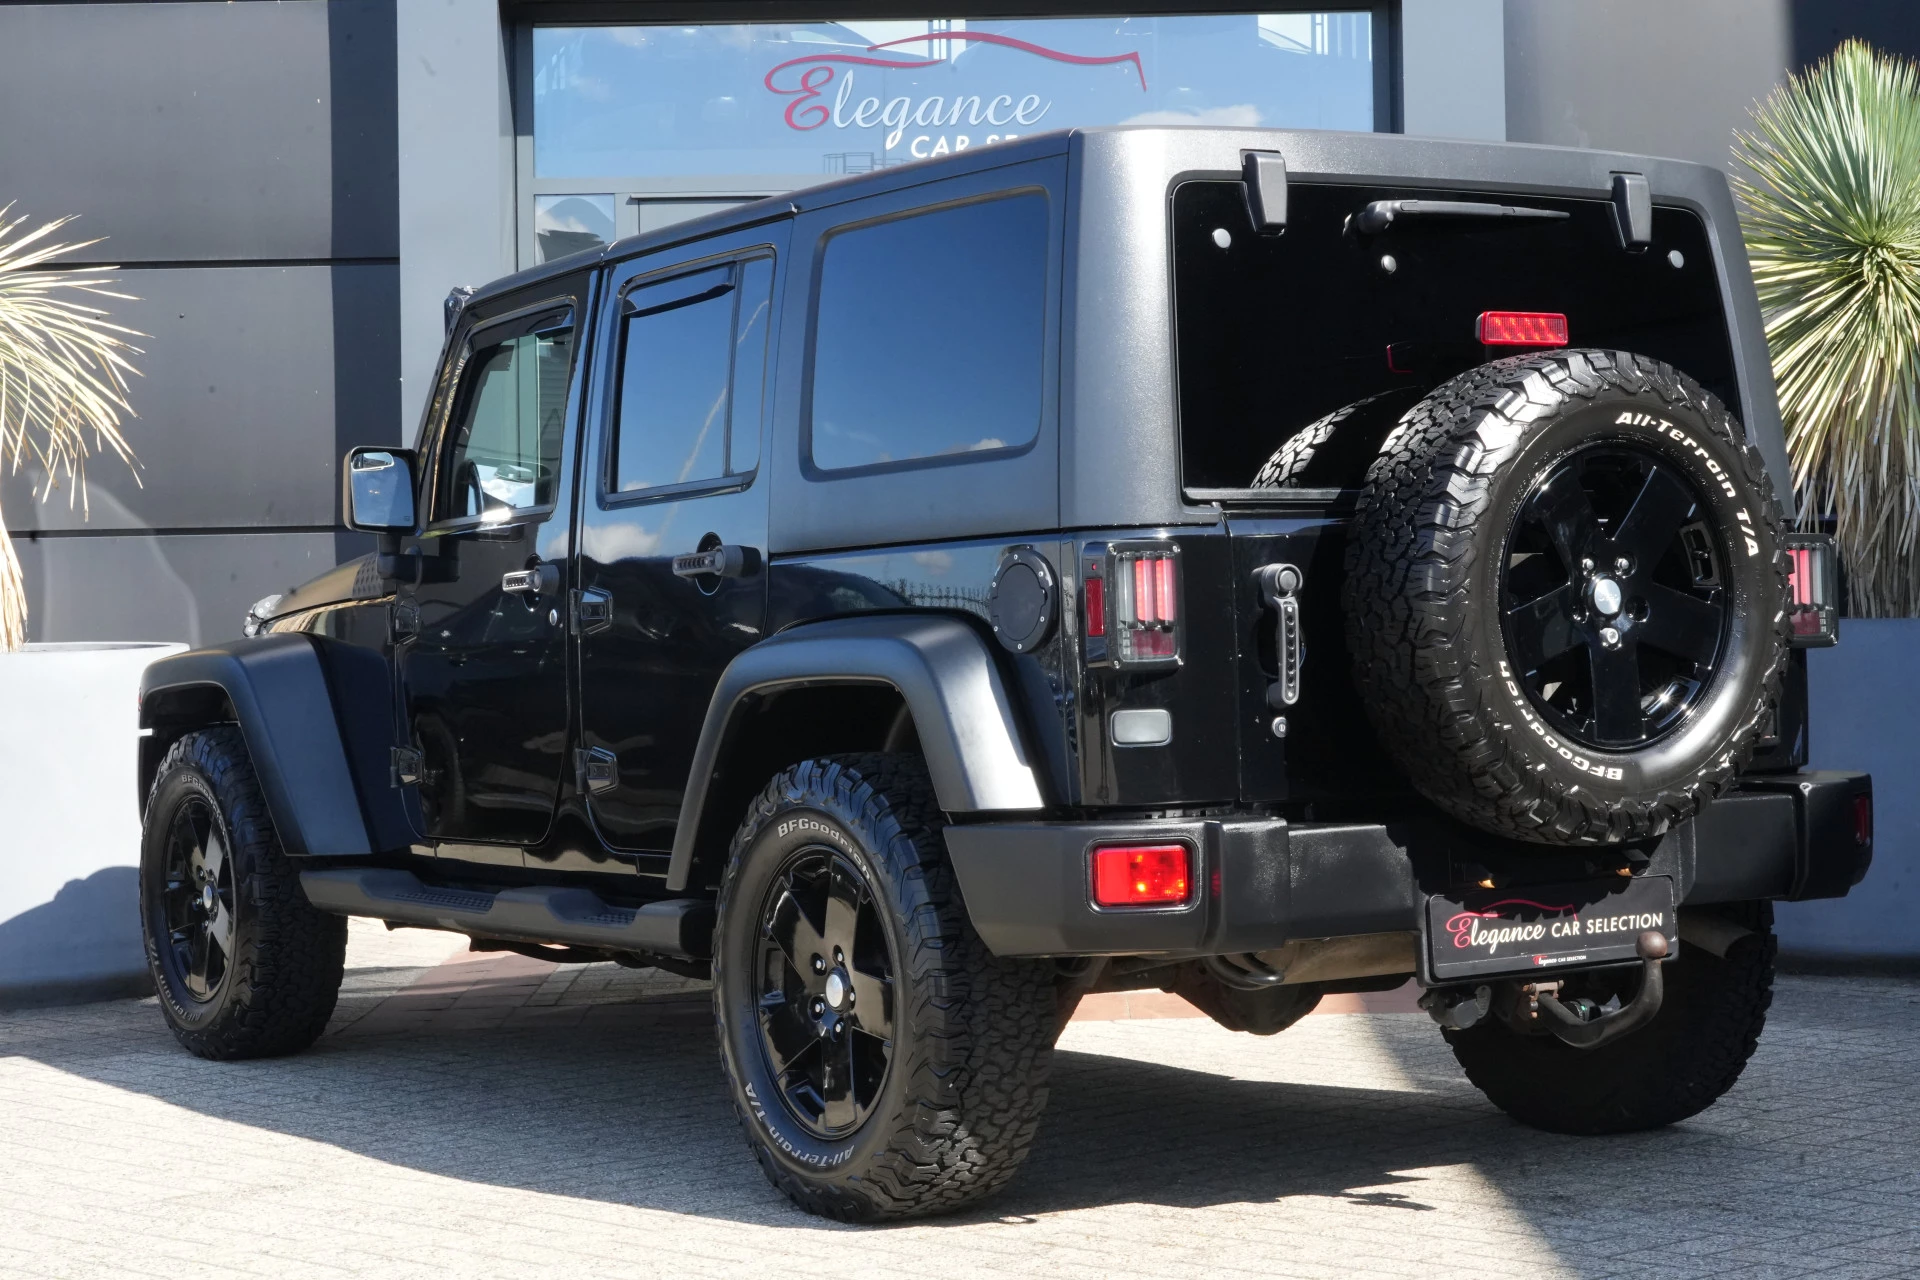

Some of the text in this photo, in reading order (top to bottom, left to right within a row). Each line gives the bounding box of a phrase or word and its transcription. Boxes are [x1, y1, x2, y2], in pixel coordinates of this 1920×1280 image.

[764, 54, 1052, 150] Elegance
[911, 135, 970, 158] CAR
[1615, 411, 1759, 557] All-Terrain T/A
[1498, 660, 1623, 781] BFGoodrich
[777, 818, 870, 880] BFGoodrich
[1446, 911, 1663, 954] Elegance CAR SELECTION
[745, 1082, 855, 1168] All-Terrain T/A
